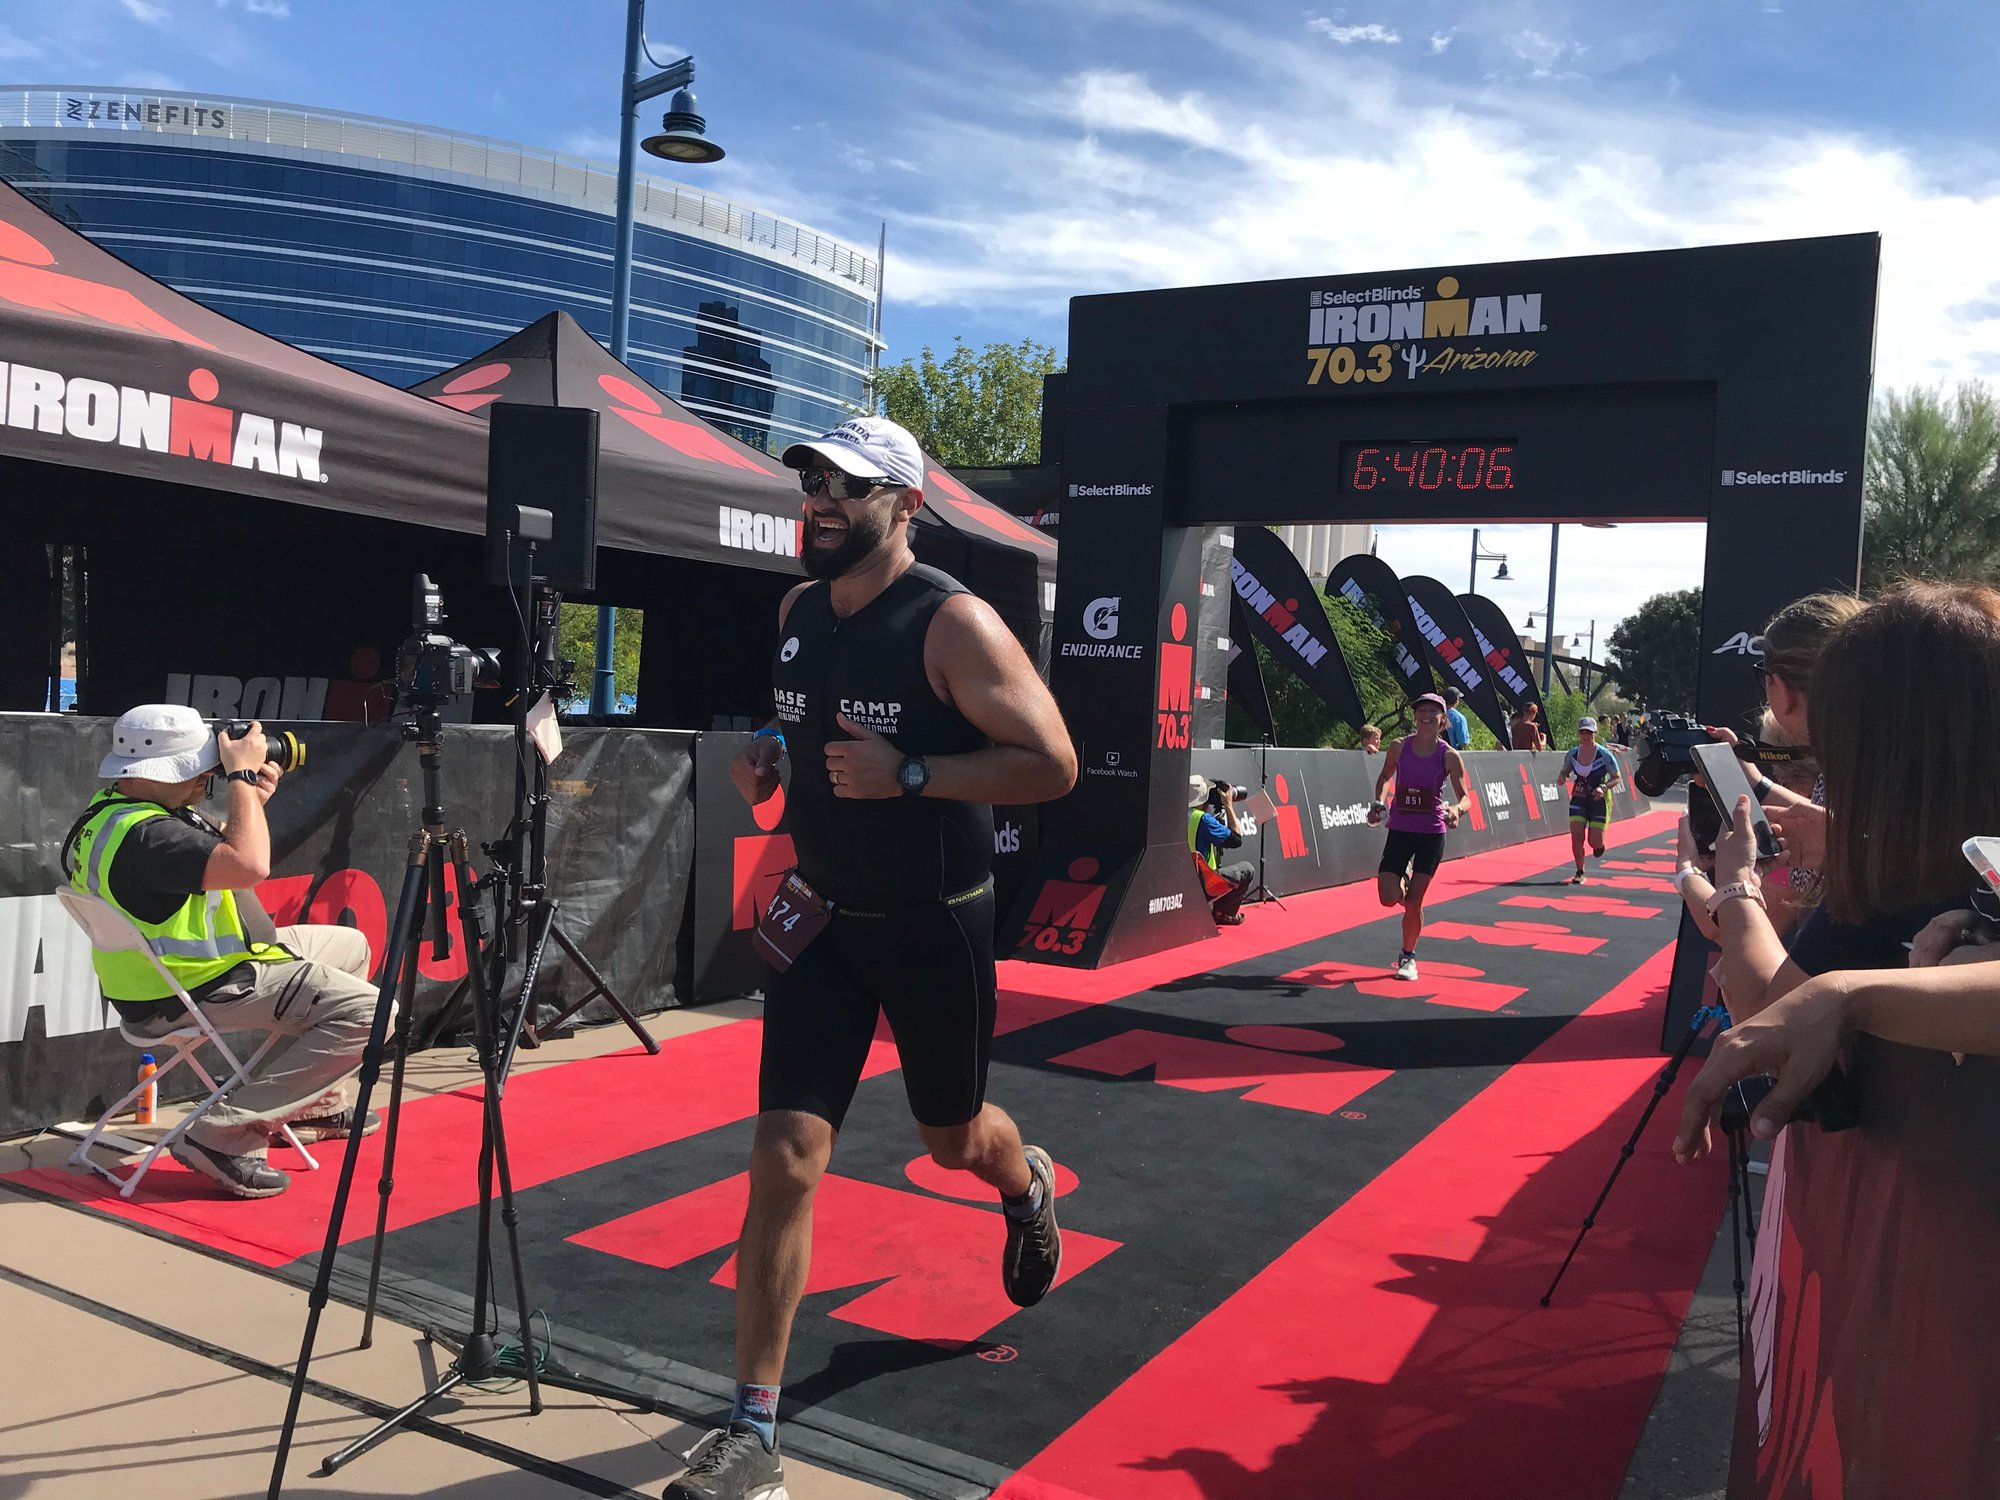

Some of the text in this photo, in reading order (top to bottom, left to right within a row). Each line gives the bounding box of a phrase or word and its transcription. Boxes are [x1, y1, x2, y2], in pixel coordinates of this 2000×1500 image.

[88, 100, 225, 129] ZENEFITS
[1322, 285, 1422, 306] SelectBlinds
[1308, 276, 1543, 346] IRONMAN
[1306, 343, 1541, 386] 70.3 Arizona
[1736, 469, 1845, 485] SelectBlinds
[1078, 483, 1152, 497] SelectBlinds
[719, 505, 805, 558] IRON
[1231, 555, 1328, 667] RONMAN
[1061, 643, 1144, 660] ENDURANCE
[773, 687, 807, 708] ASE
[840, 699, 902, 717] CAMP
[846, 714, 898, 725] THERAPY
[1157, 713, 1190, 750] 70.3
[1759, 751, 1792, 761] Nikon
[1086, 766, 1139, 778] Facebook Watch
[1405, 795, 1421, 806] 851
[955, 887, 985, 904] NATHAN
[1148, 893, 1184, 915] #IM703AZ
[767, 894, 802, 933] 474
[847, 910, 886, 919] NATHAN
[1016, 924, 1088, 955] 70.3
